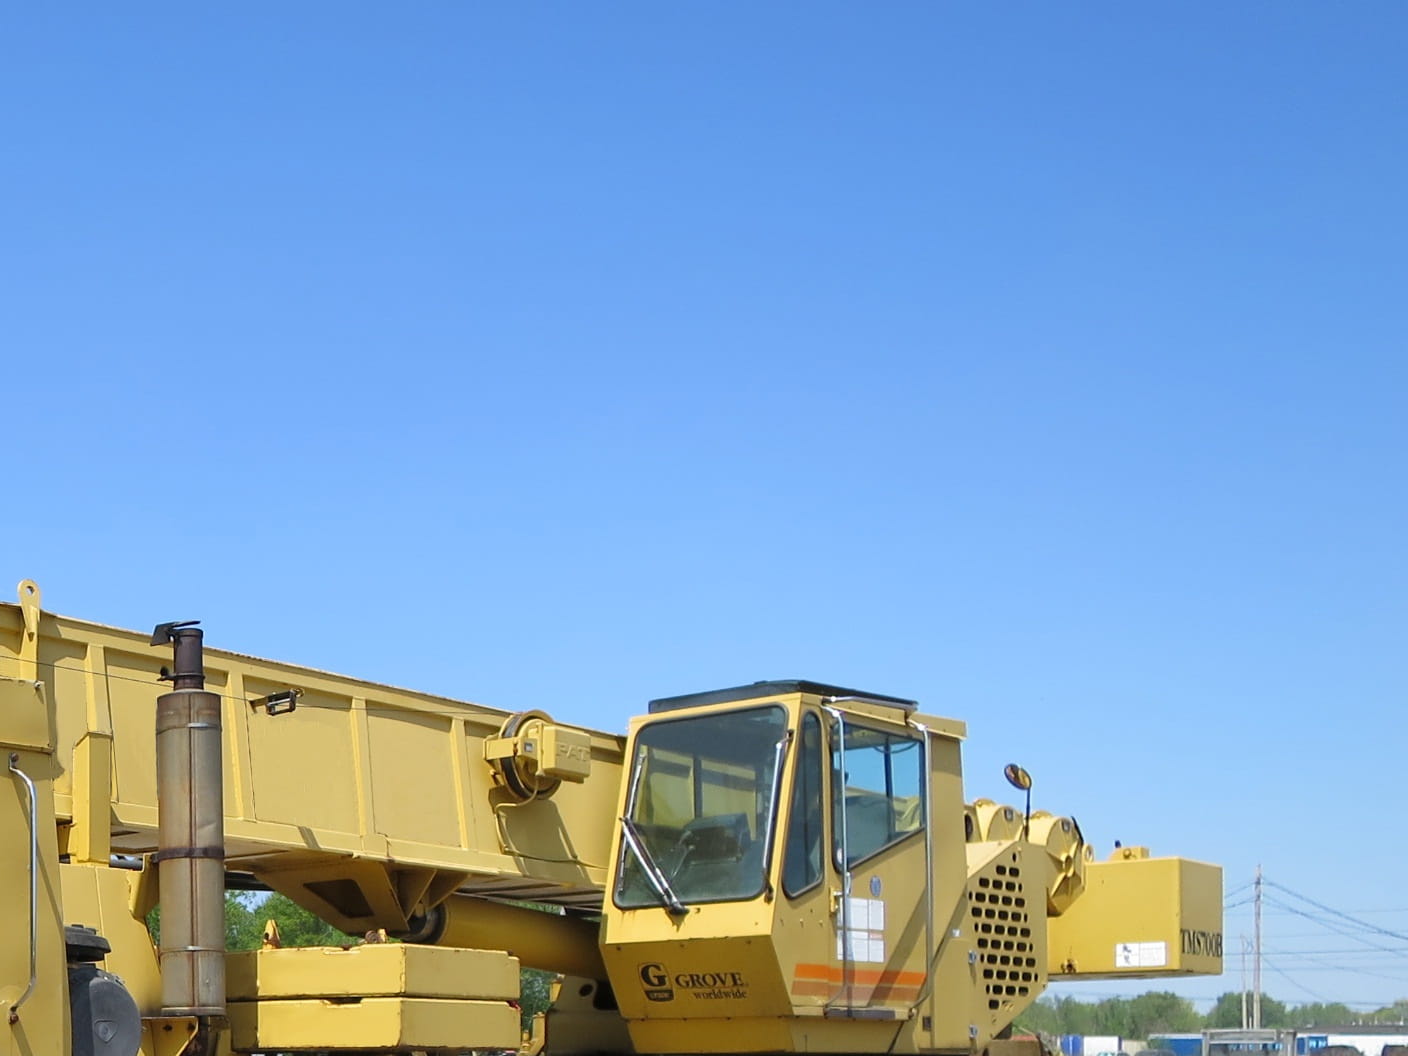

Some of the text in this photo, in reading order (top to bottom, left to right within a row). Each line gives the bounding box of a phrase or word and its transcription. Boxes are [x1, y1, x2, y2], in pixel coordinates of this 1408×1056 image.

[1180, 929, 1223, 958] TMS700B
[675, 971, 745, 989] GROVE
[694, 988, 747, 1000] worldwide
